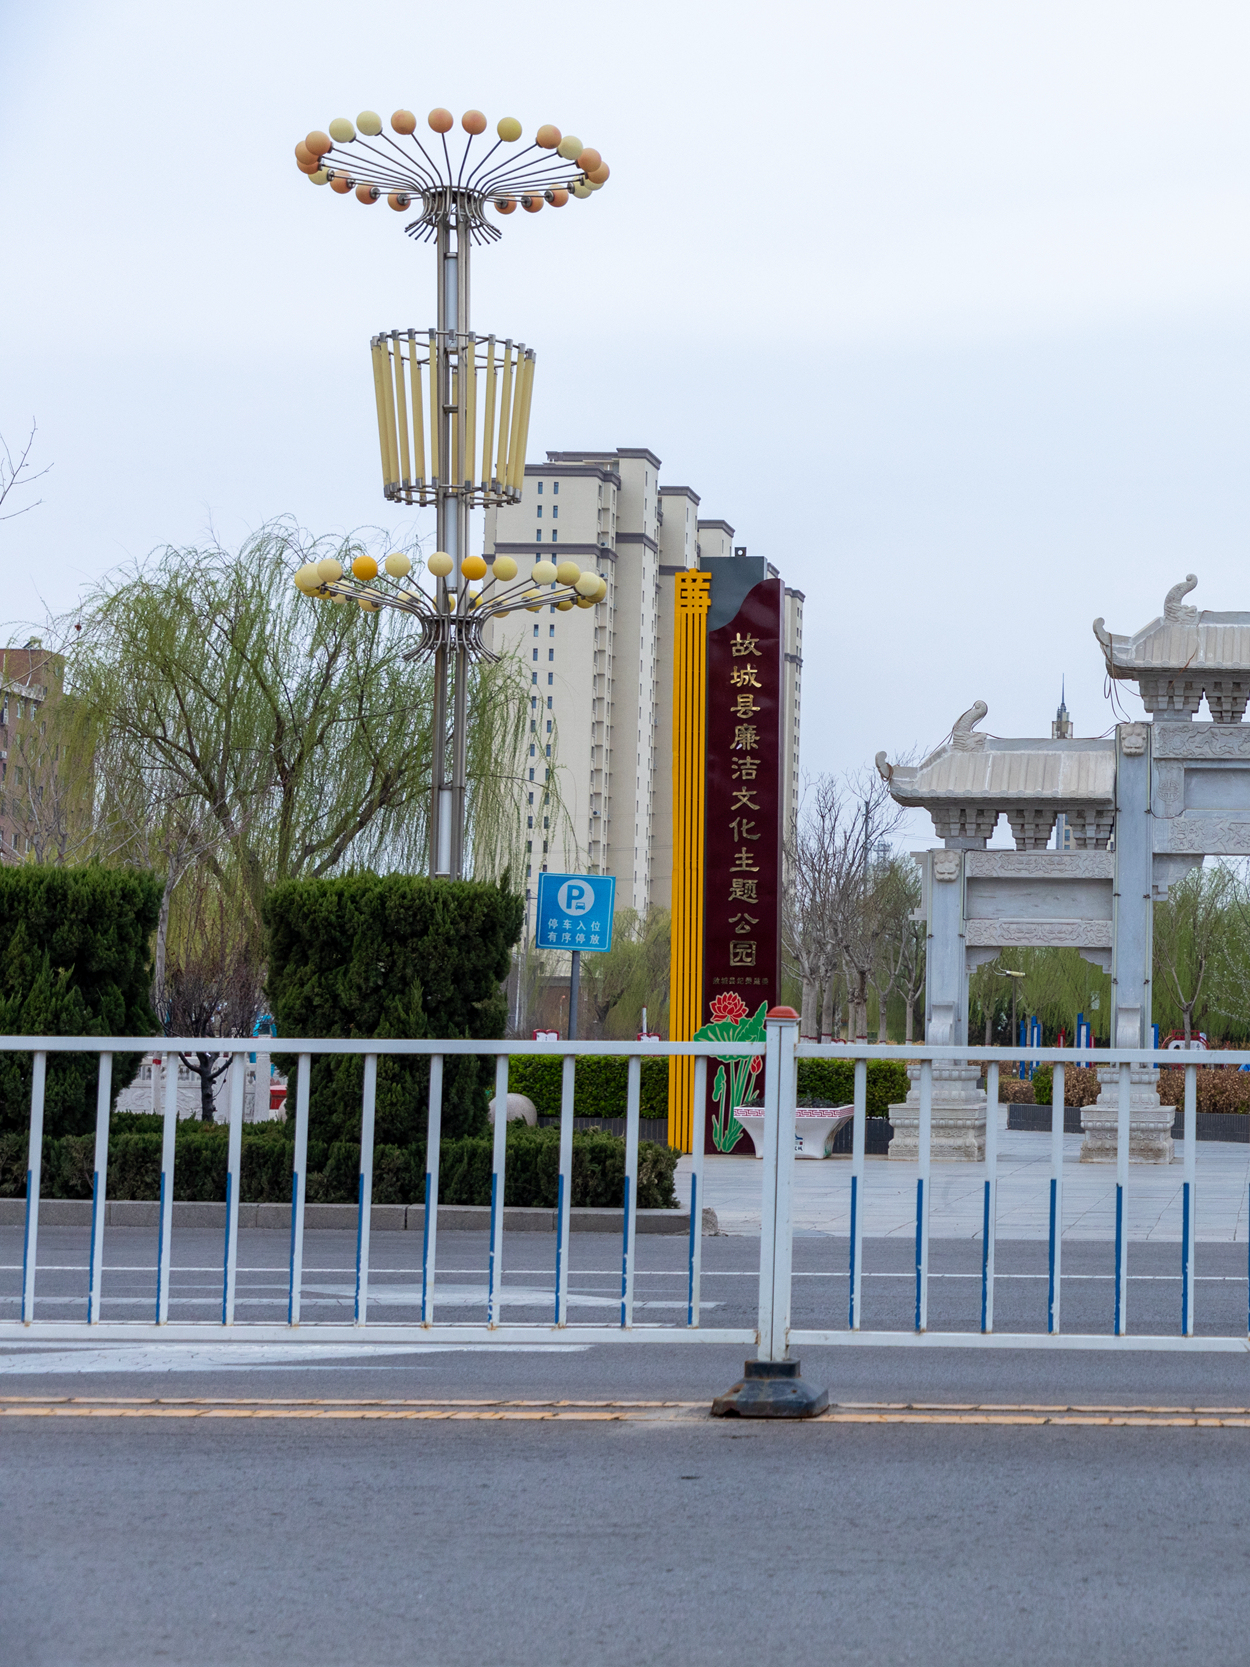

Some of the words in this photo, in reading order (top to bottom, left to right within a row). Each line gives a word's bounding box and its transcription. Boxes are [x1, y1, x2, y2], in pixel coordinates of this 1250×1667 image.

[728, 631, 762, 968] 故城县廉洁文化主题公园
[565, 884, 585, 910] P
[547, 918, 601, 932] 停车入位
[547, 931, 600, 945] 有序停放
